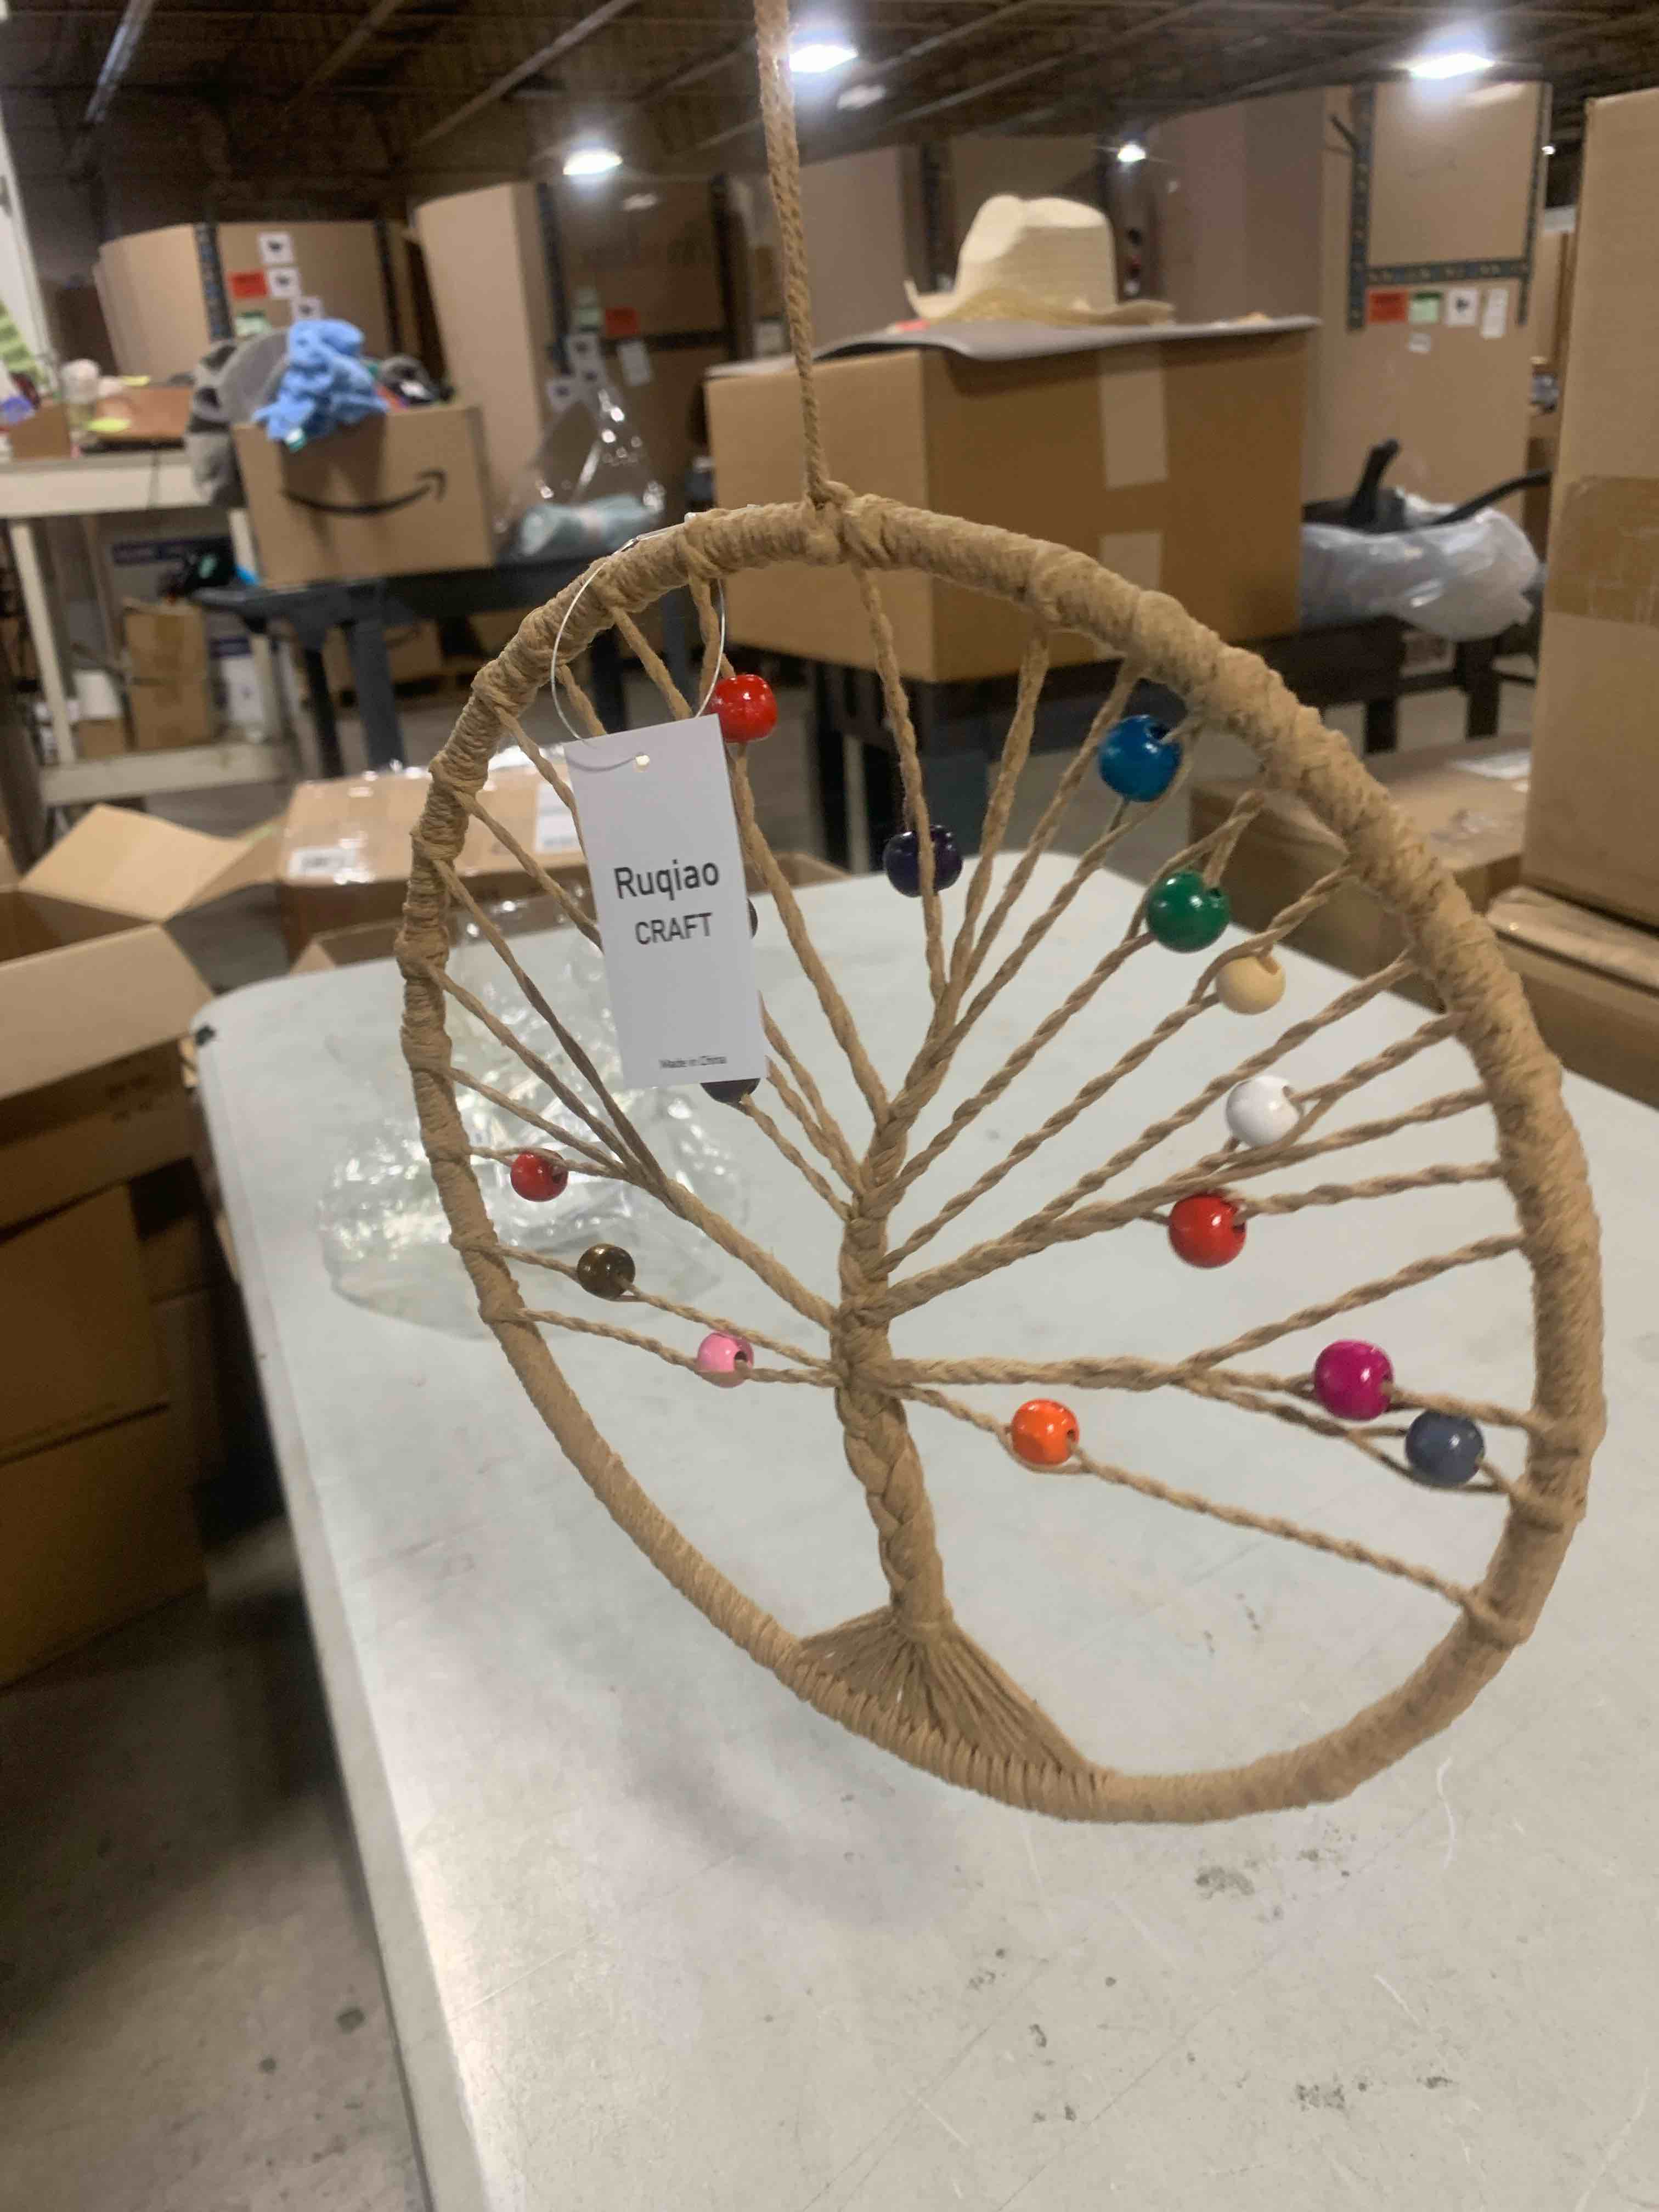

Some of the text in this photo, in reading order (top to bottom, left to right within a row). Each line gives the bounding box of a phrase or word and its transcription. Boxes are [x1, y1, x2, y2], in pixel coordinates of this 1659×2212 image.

[614, 859, 719, 900] Ruqiao
[635, 912, 713, 945] CRAFT
[659, 1058, 686, 1069] Made
[698, 1054, 727, 1066] China
